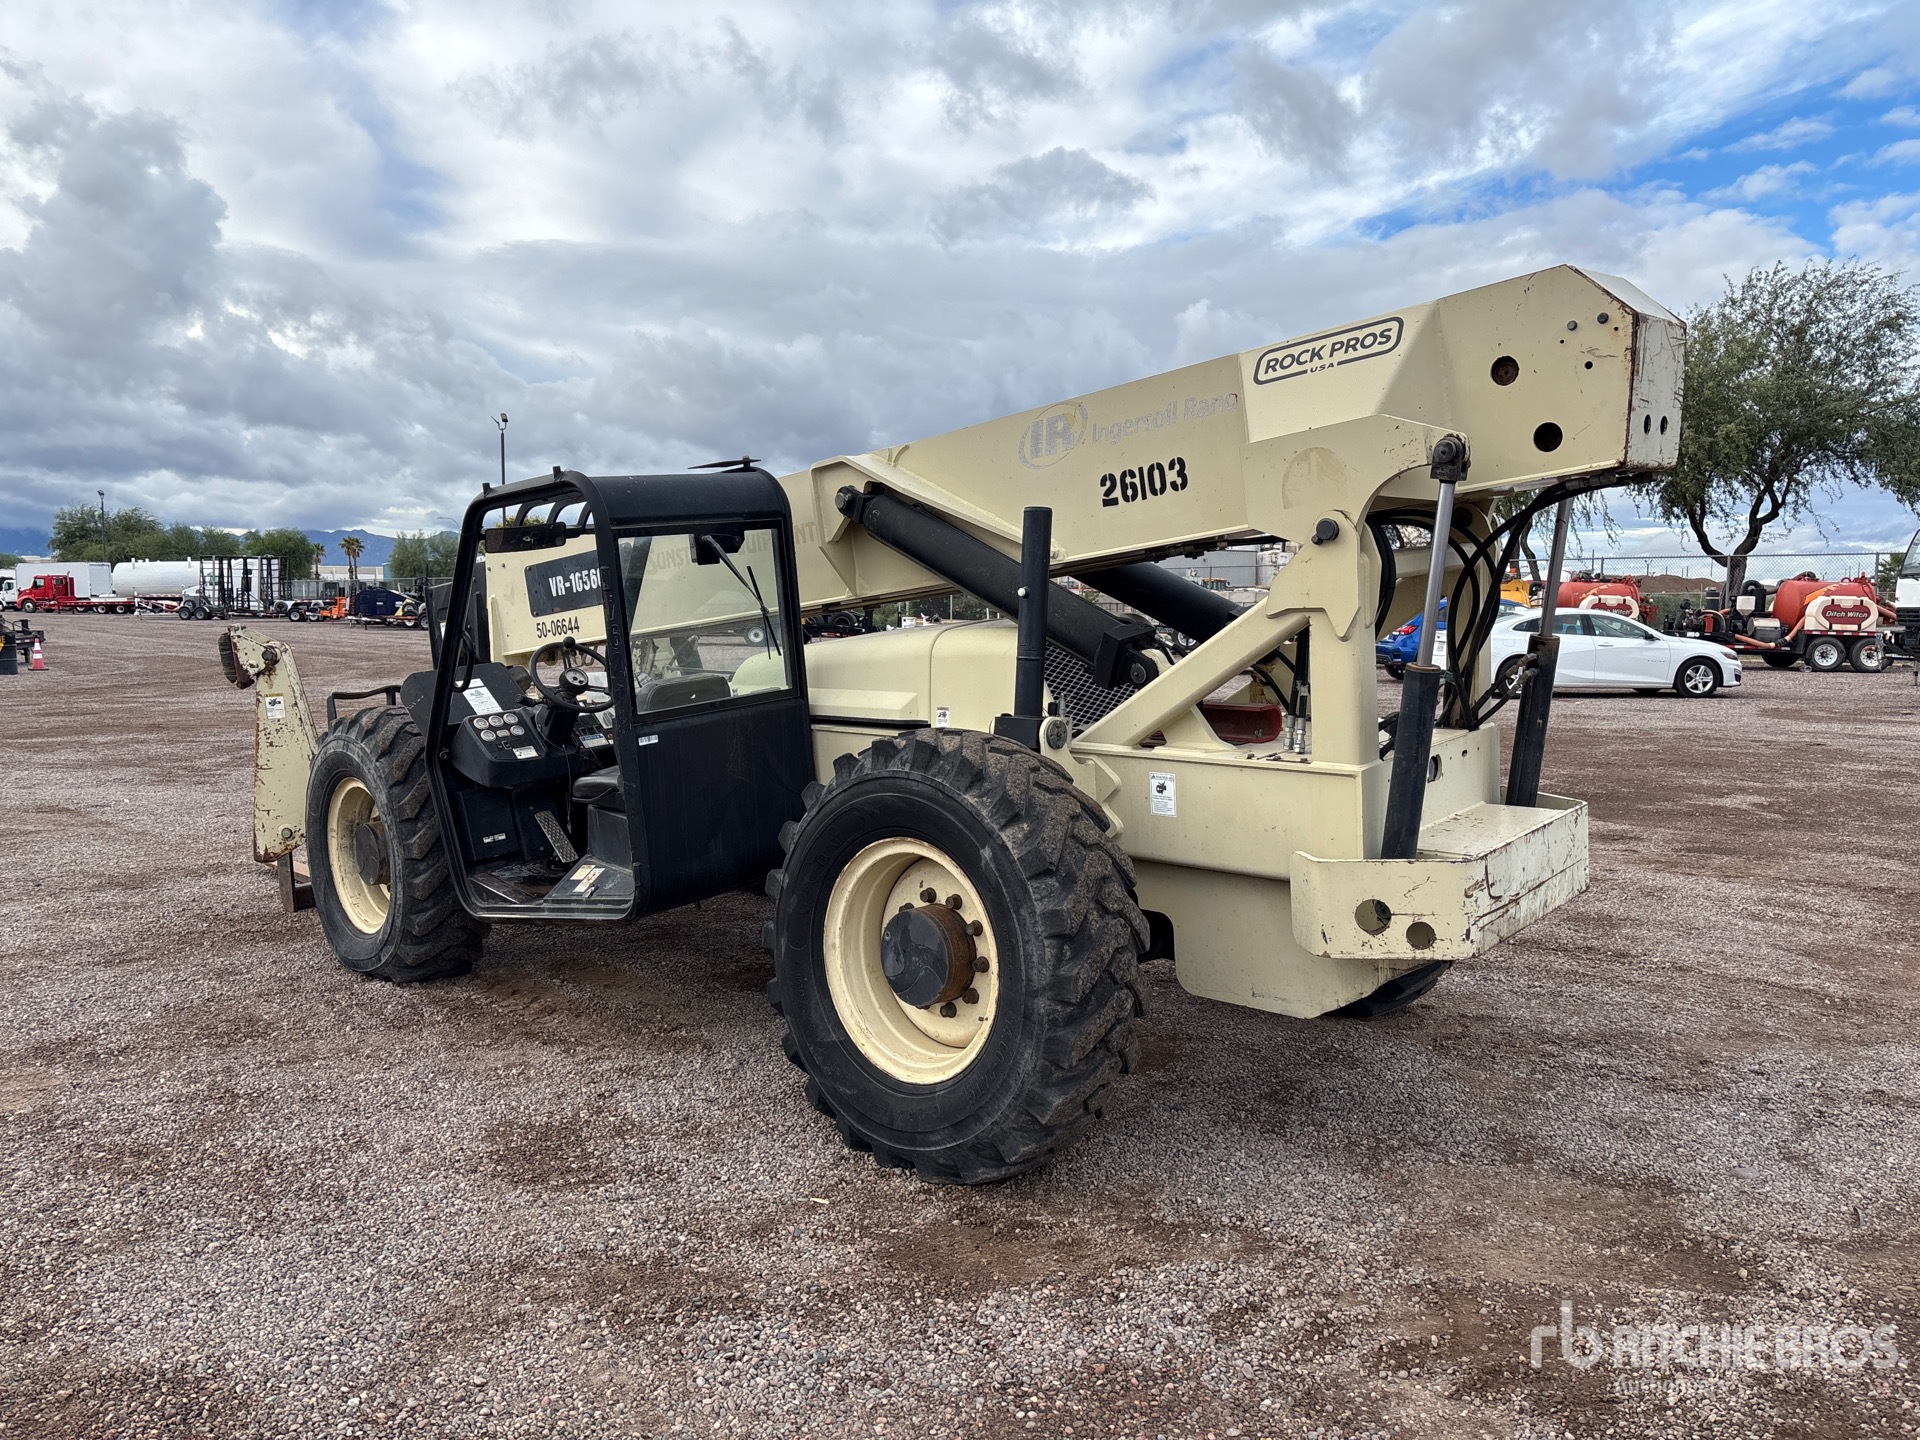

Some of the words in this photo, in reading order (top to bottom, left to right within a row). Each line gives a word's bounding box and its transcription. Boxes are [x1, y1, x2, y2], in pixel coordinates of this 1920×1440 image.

[1264, 343, 1328, 375] ROCK
[1329, 327, 1393, 358] PROS
[1309, 362, 1335, 374] USA
[1029, 413, 1075, 460] IR
[1092, 400, 1178, 445] Ingersoll
[1100, 456, 1189, 508] 26103
[648, 546, 692, 575] SUNST
[536, 615, 580, 639] 50-06644
[1847, 611, 1868, 619] Witch
